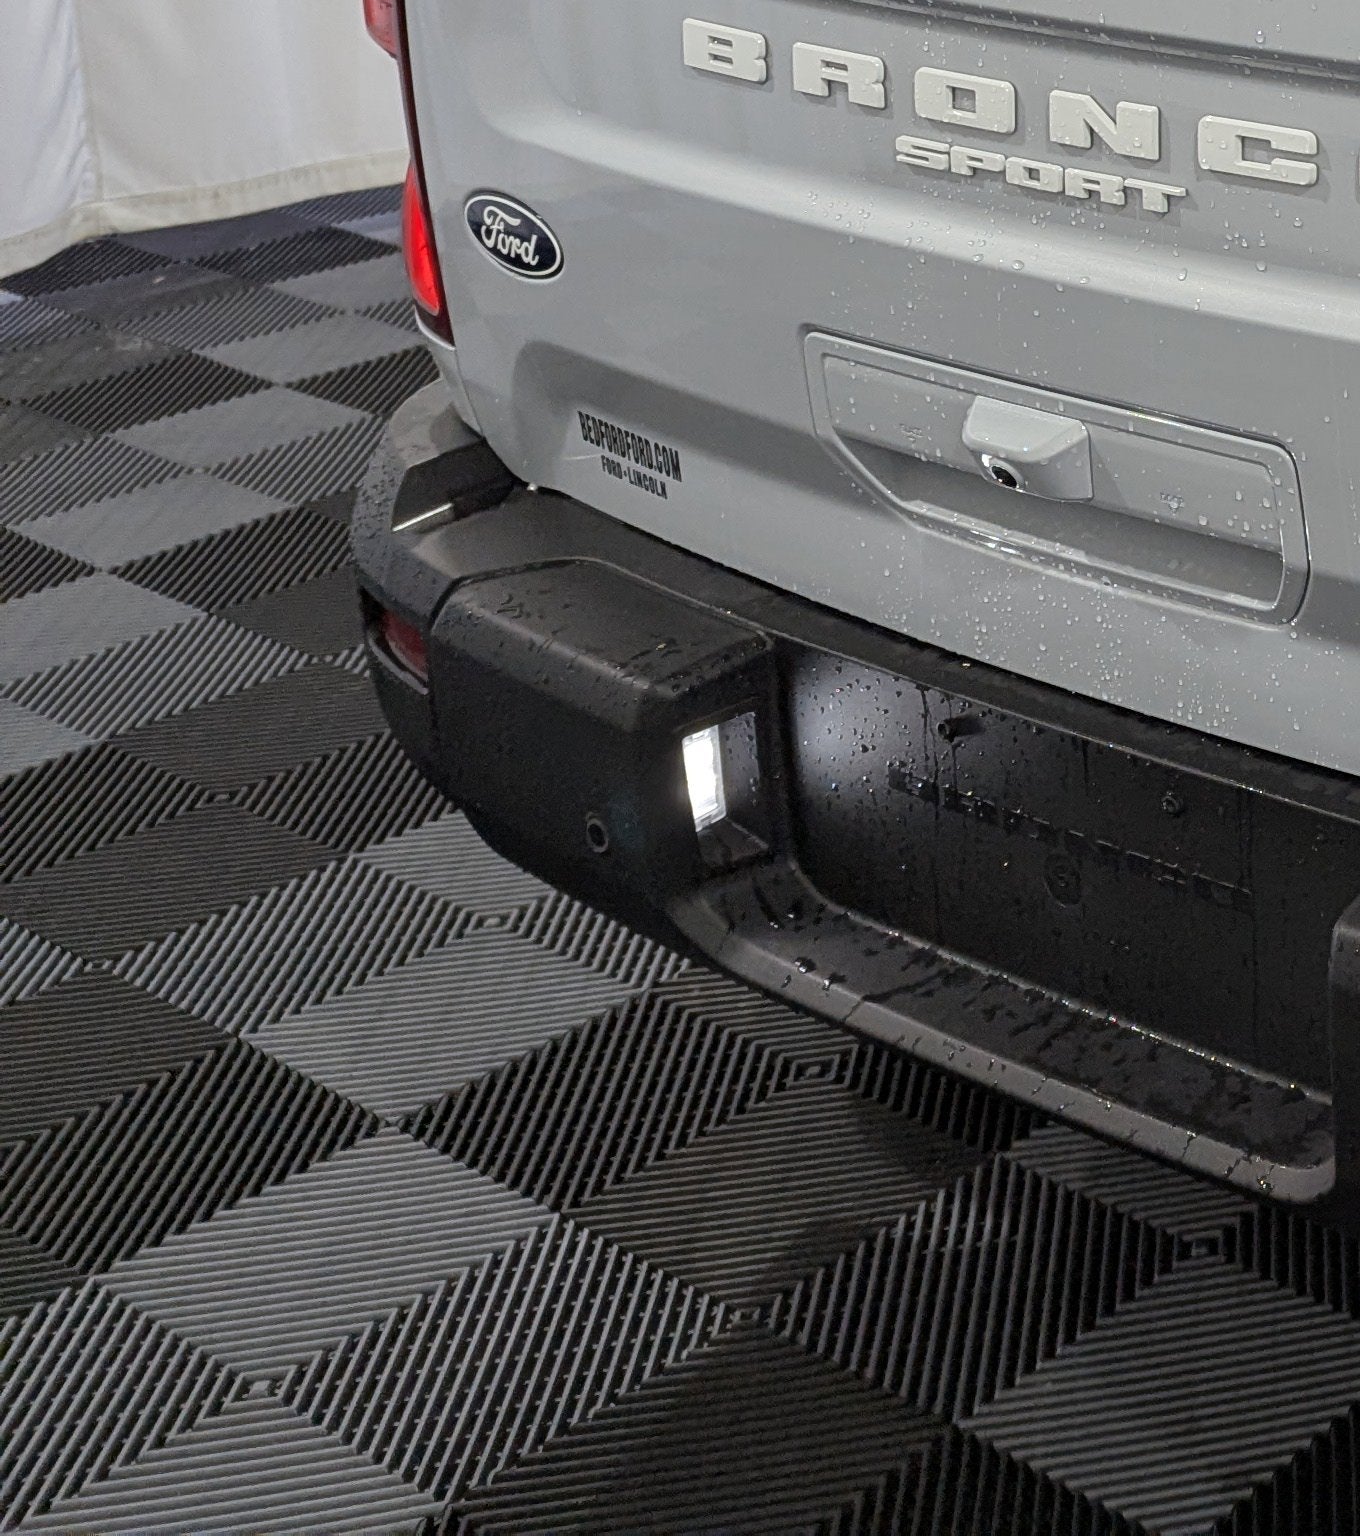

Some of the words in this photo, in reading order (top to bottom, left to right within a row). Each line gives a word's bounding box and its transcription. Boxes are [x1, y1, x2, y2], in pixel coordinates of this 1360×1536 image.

[896, 135, 1187, 213] SPORT
[481, 205, 540, 266] Ford
[577, 410, 682, 482] BEDFORDFORD.COM
[601, 454, 623, 479] FORD
[627, 466, 668, 500] LINCOLN
